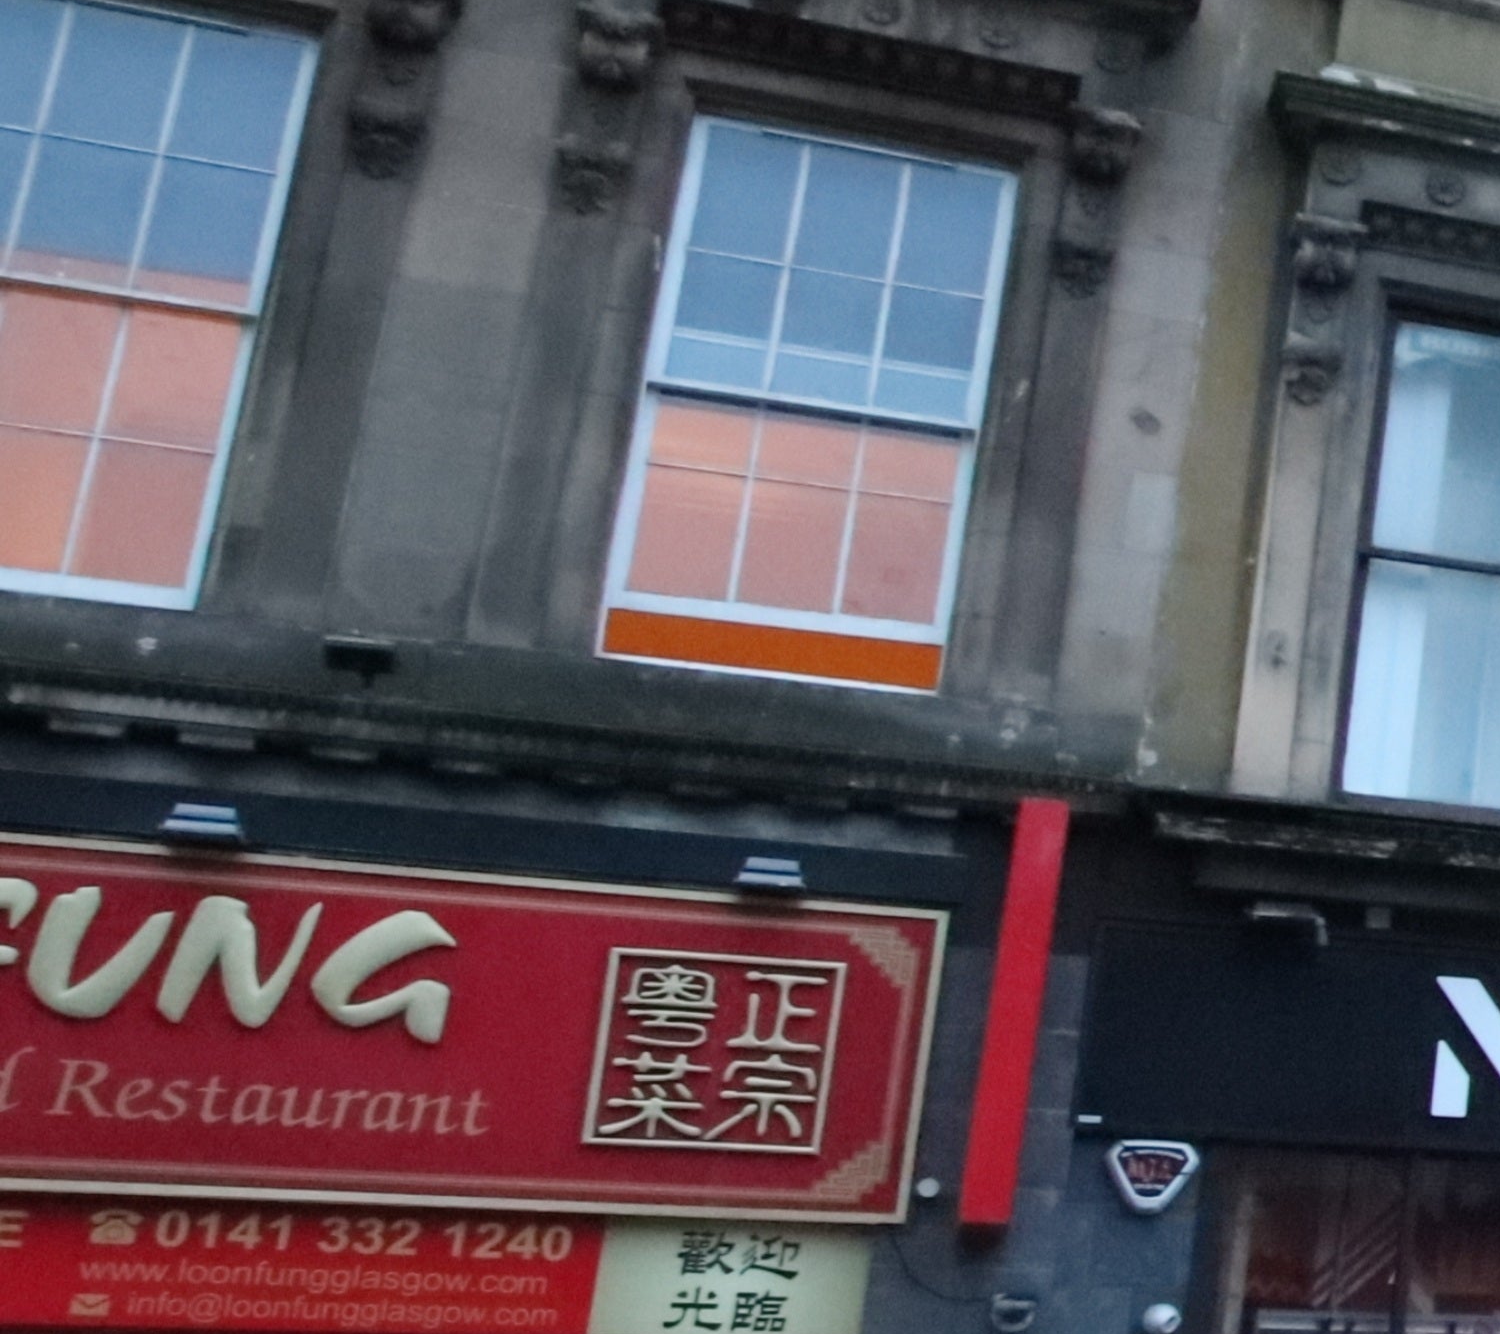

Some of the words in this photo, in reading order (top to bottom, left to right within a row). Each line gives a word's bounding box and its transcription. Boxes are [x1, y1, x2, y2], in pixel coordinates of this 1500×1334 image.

[45, 1058, 491, 1137] Restaurant
[154, 1209, 294, 1251] 0141
[316, 1215, 421, 1257] 332
[443, 1220, 574, 1262] 1240
[78, 1257, 549, 1298] www.loonfungglasgow.com
[126, 1290, 559, 1329] info@loonfungglasgow.com
